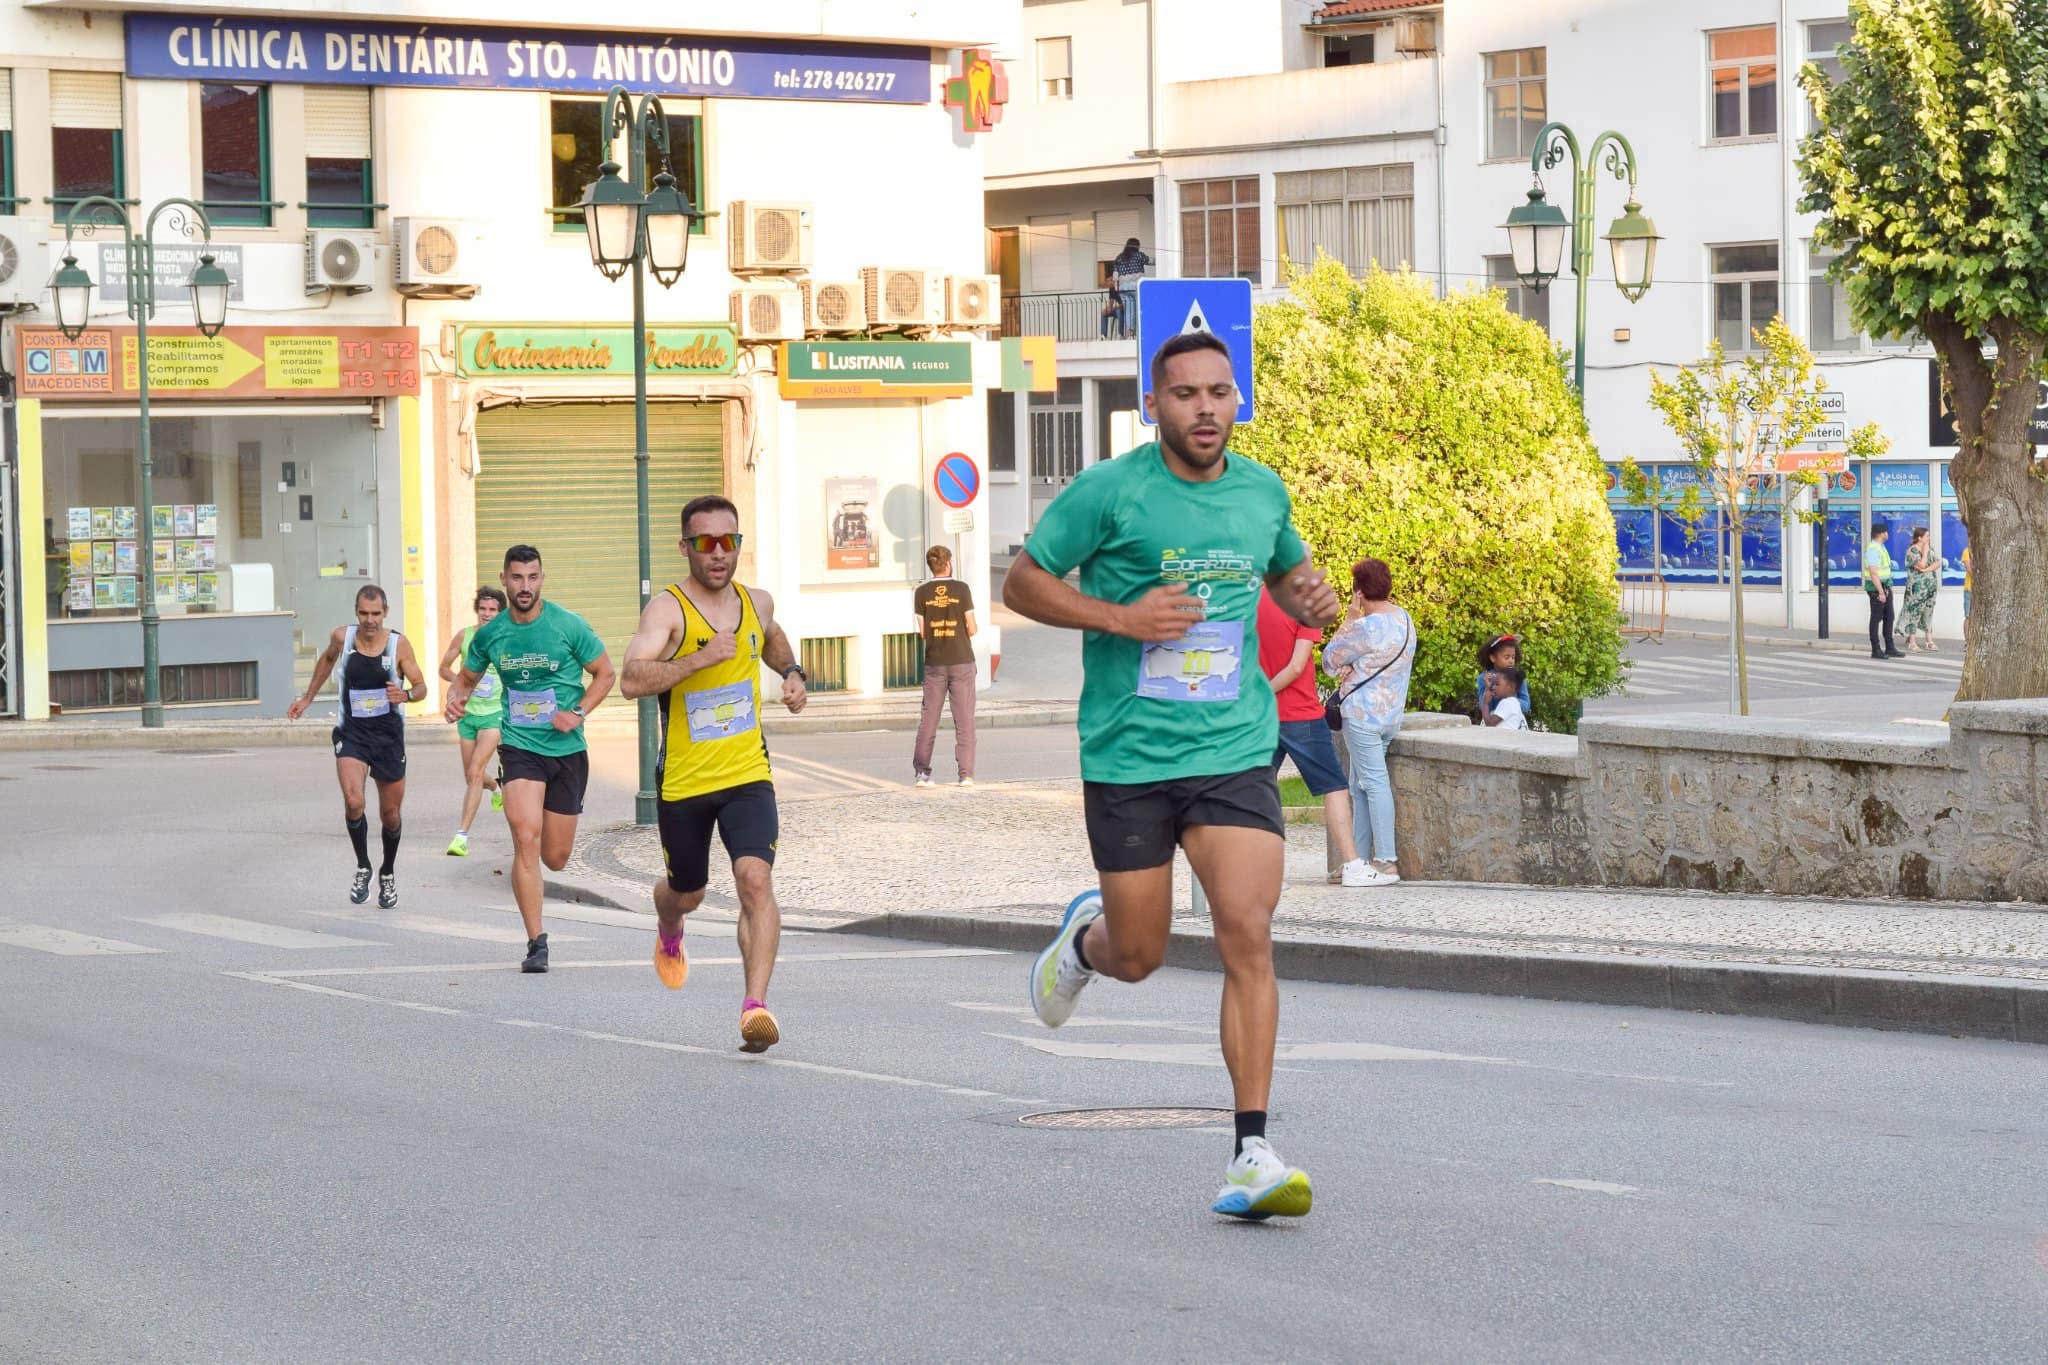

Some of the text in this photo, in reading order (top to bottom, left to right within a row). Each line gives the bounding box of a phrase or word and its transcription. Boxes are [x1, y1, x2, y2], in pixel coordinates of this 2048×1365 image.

[168, 18, 735, 87] CLÍNICA DENTÁRIA STO. ANTÓNIO
[774, 68, 896, 91] tel: 278 426 277
[269, 339, 333, 347] apartamentos
[342, 341, 416, 359] T1 T2
[29, 350, 105, 373] C M
[147, 351, 224, 361] Reabilitamos
[280, 358, 323, 366] moradias
[912, 361, 950, 370] SEGUROS
[147, 364, 219, 375] Compramos
[26, 377, 109, 389] MACEDENSE
[148, 376, 210, 386] Vendemos
[343, 370, 417, 388] T3 T4
